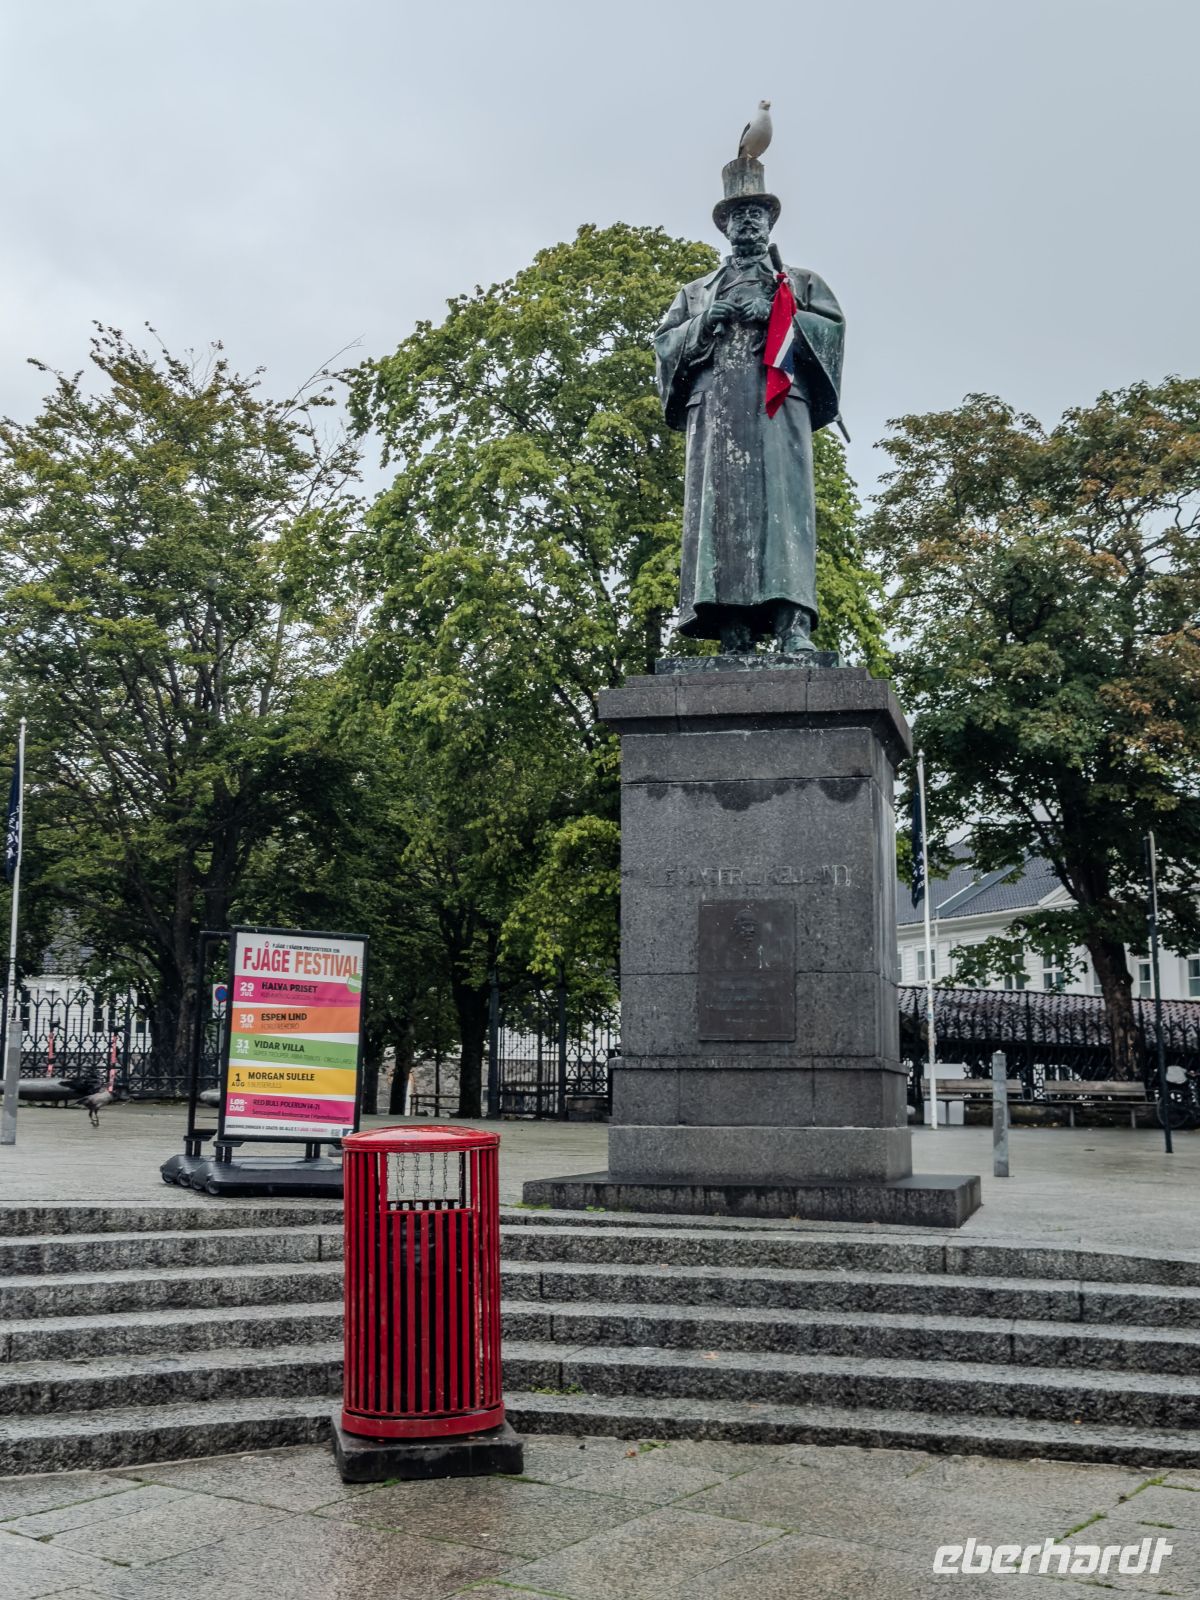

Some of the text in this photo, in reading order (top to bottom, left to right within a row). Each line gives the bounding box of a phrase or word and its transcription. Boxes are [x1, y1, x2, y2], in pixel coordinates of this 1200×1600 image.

[243, 946, 358, 978] FJÅGE FESTIVAL
[240, 981, 254, 992] 29
[261, 981, 318, 994] HALVA PRISET
[240, 1013, 254, 1024] 30
[261, 1012, 307, 1021] ESPEN LIND
[254, 1040, 305, 1053] VIDAR VILLA
[235, 1073, 241, 1081] 1
[247, 1071, 315, 1081] MORGAN SULELE
